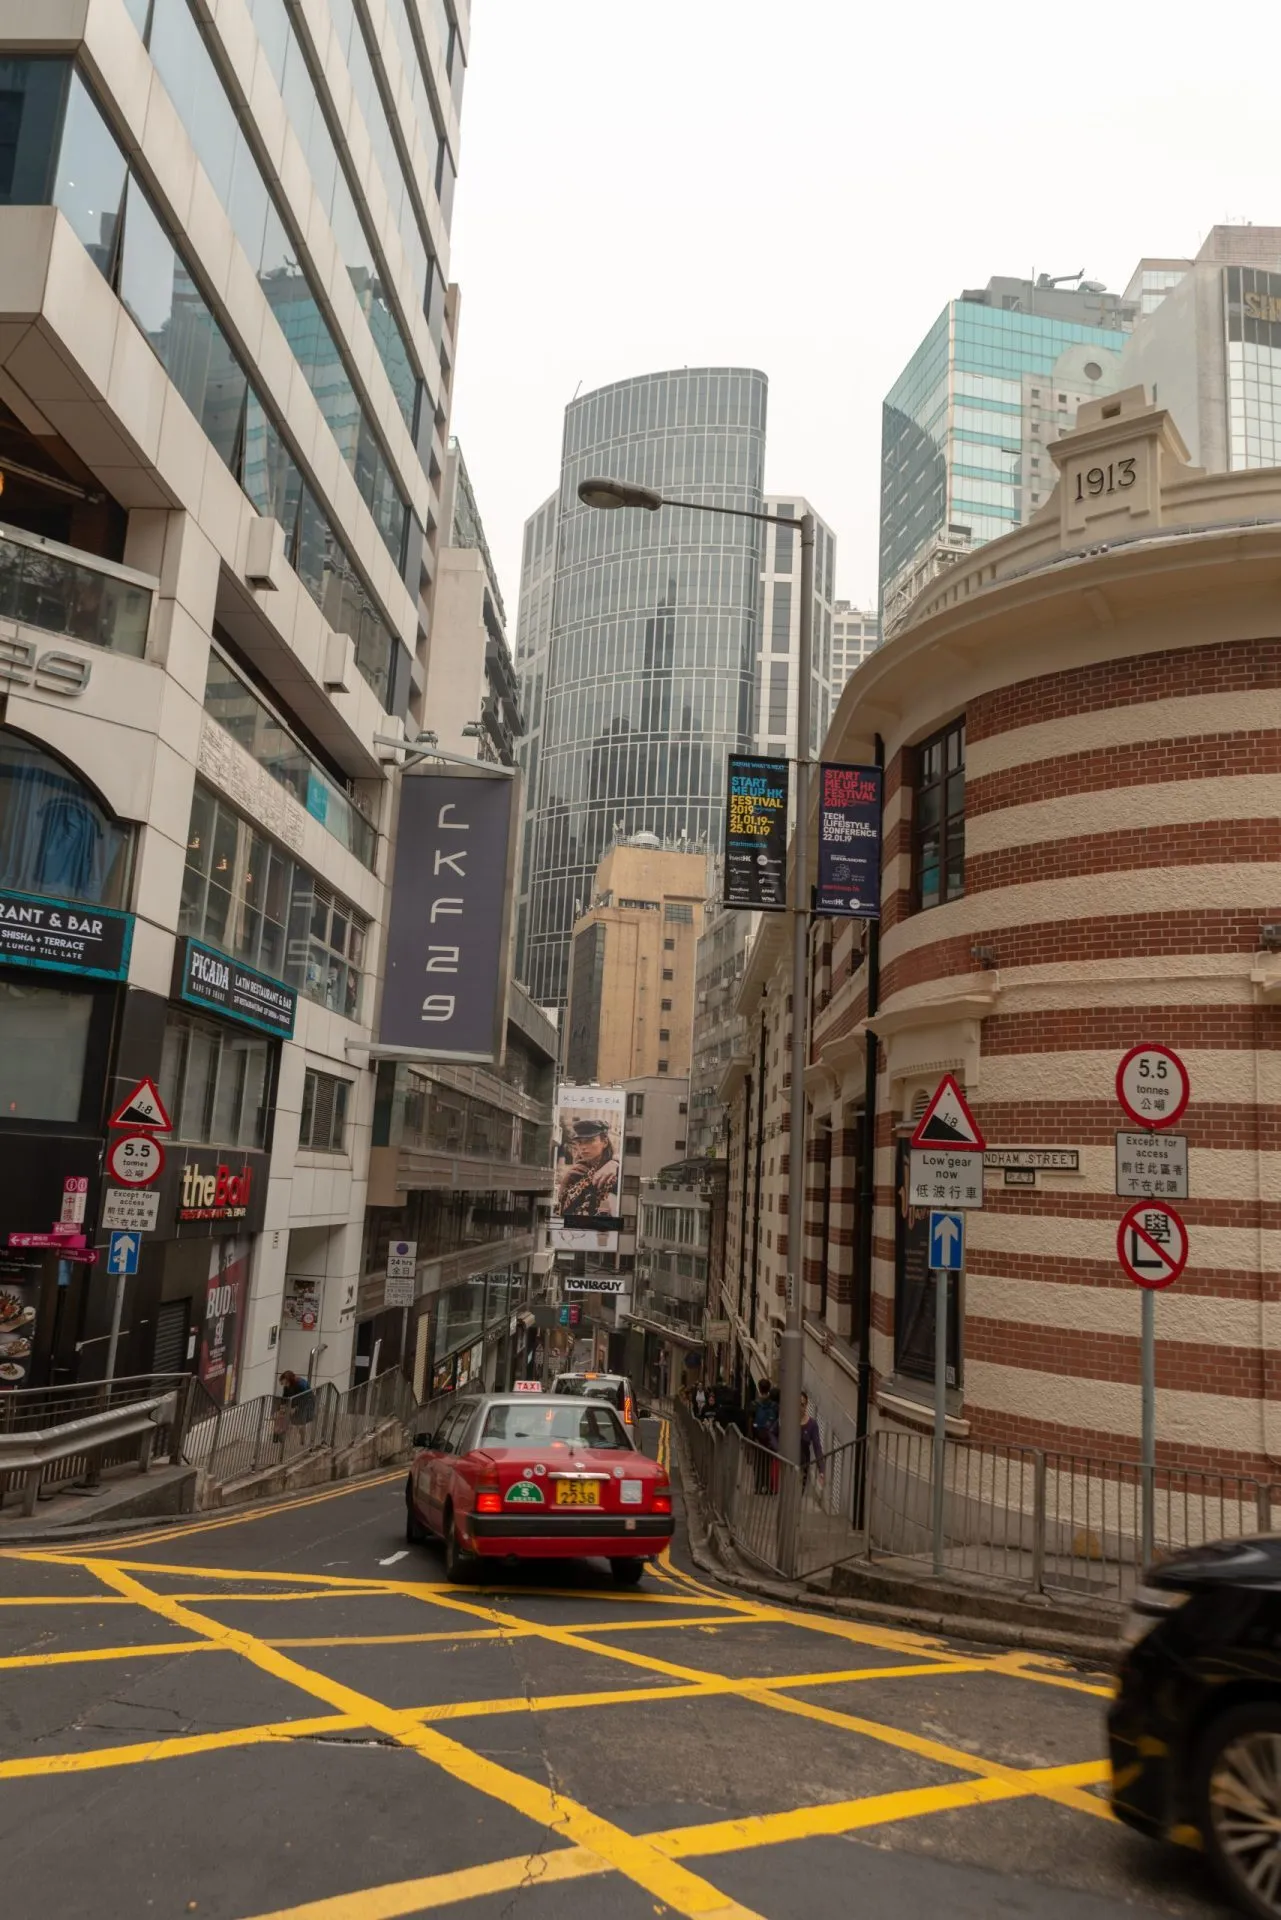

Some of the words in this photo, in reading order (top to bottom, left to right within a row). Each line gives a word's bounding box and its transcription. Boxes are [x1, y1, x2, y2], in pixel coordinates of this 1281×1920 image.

[1075, 457, 1136, 502] 1913
[825, 769, 860, 780] START
[731, 776, 768, 788] START
[825, 779, 841, 788] ME
[843, 780, 858, 790] UP
[860, 782, 876, 792] HK
[731, 786, 748, 796] ME
[750, 787, 765, 797] UP
[767, 788, 784, 798] HK
[824, 788, 877, 802] FESTIVAL
[731, 795, 784, 808] FESTIVAL
[824, 798, 849, 807] 2019
[730, 804, 754, 815] 2019
[823, 812, 845, 820] TECH
[730, 824, 770, 835] 25.01.19
[823, 826, 877, 837] CONFERENCE
[823, 834, 852, 842] 22.01.19
[48, 913, 62, 927] &
[67, 916, 103, 934] BAR
[2, 929, 34, 942] SHISHA
[44, 936, 85, 951] TERRACE
[6, 942, 36, 952] LUNCH
[40, 947, 58, 956] TILL
[61, 950, 83, 960] LATE
[190, 952, 230, 990] PICADA
[235, 974, 250, 990] LATIN
[250, 980, 279, 1004] RESTAURANT
[283, 996, 293, 1010] BAR
[1138, 1058, 1168, 1079] 5.5
[1136, 1085, 1170, 1096] tonnes
[137, 1101, 153, 1115] 1:8
[942, 1112, 958, 1128] 1:8
[1126, 1136, 1159, 1147] Except
[1163, 1137, 1178, 1148] for
[124, 1143, 151, 1158] 5.5
[1135, 1150, 1169, 1159] access
[123, 1159, 149, 1168] tonnes
[922, 1154, 946, 1165] Low
[948, 1157, 972, 1168] gear
[1028, 1153, 1077, 1165] STREET
[935, 1169, 958, 1179] now
[1121, 1162, 1184, 1176] 前往此區者
[1128, 1178, 1178, 1192] 不在此限
[113, 1190, 140, 1199] Except
[142, 1191, 153, 1199] for
[915, 1184, 978, 1200] 低波行車
[119, 1198, 145, 1206] access
[566, 1278, 622, 1291] TONI&GUY
[516, 1382, 541, 1391] TAXI
